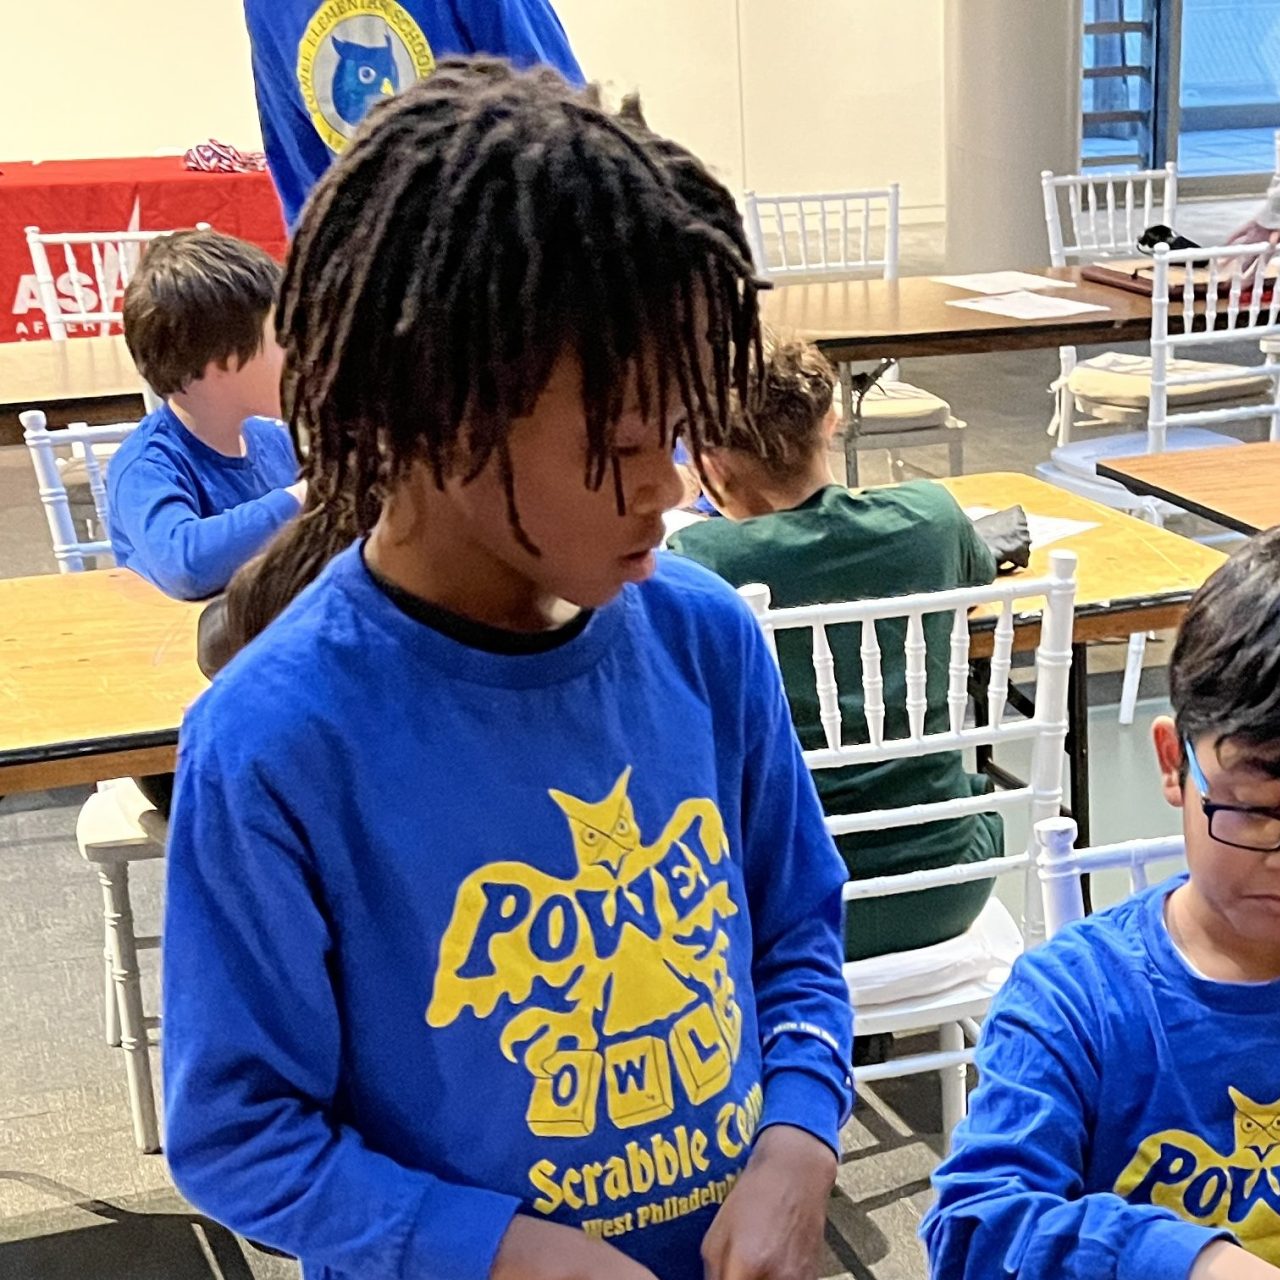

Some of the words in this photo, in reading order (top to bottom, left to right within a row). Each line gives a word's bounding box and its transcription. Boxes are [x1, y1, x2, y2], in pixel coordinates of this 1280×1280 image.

[15, 321, 97, 336] AFER
[528, 1124, 711, 1215] Scrabble
[581, 1211, 634, 1239] West
